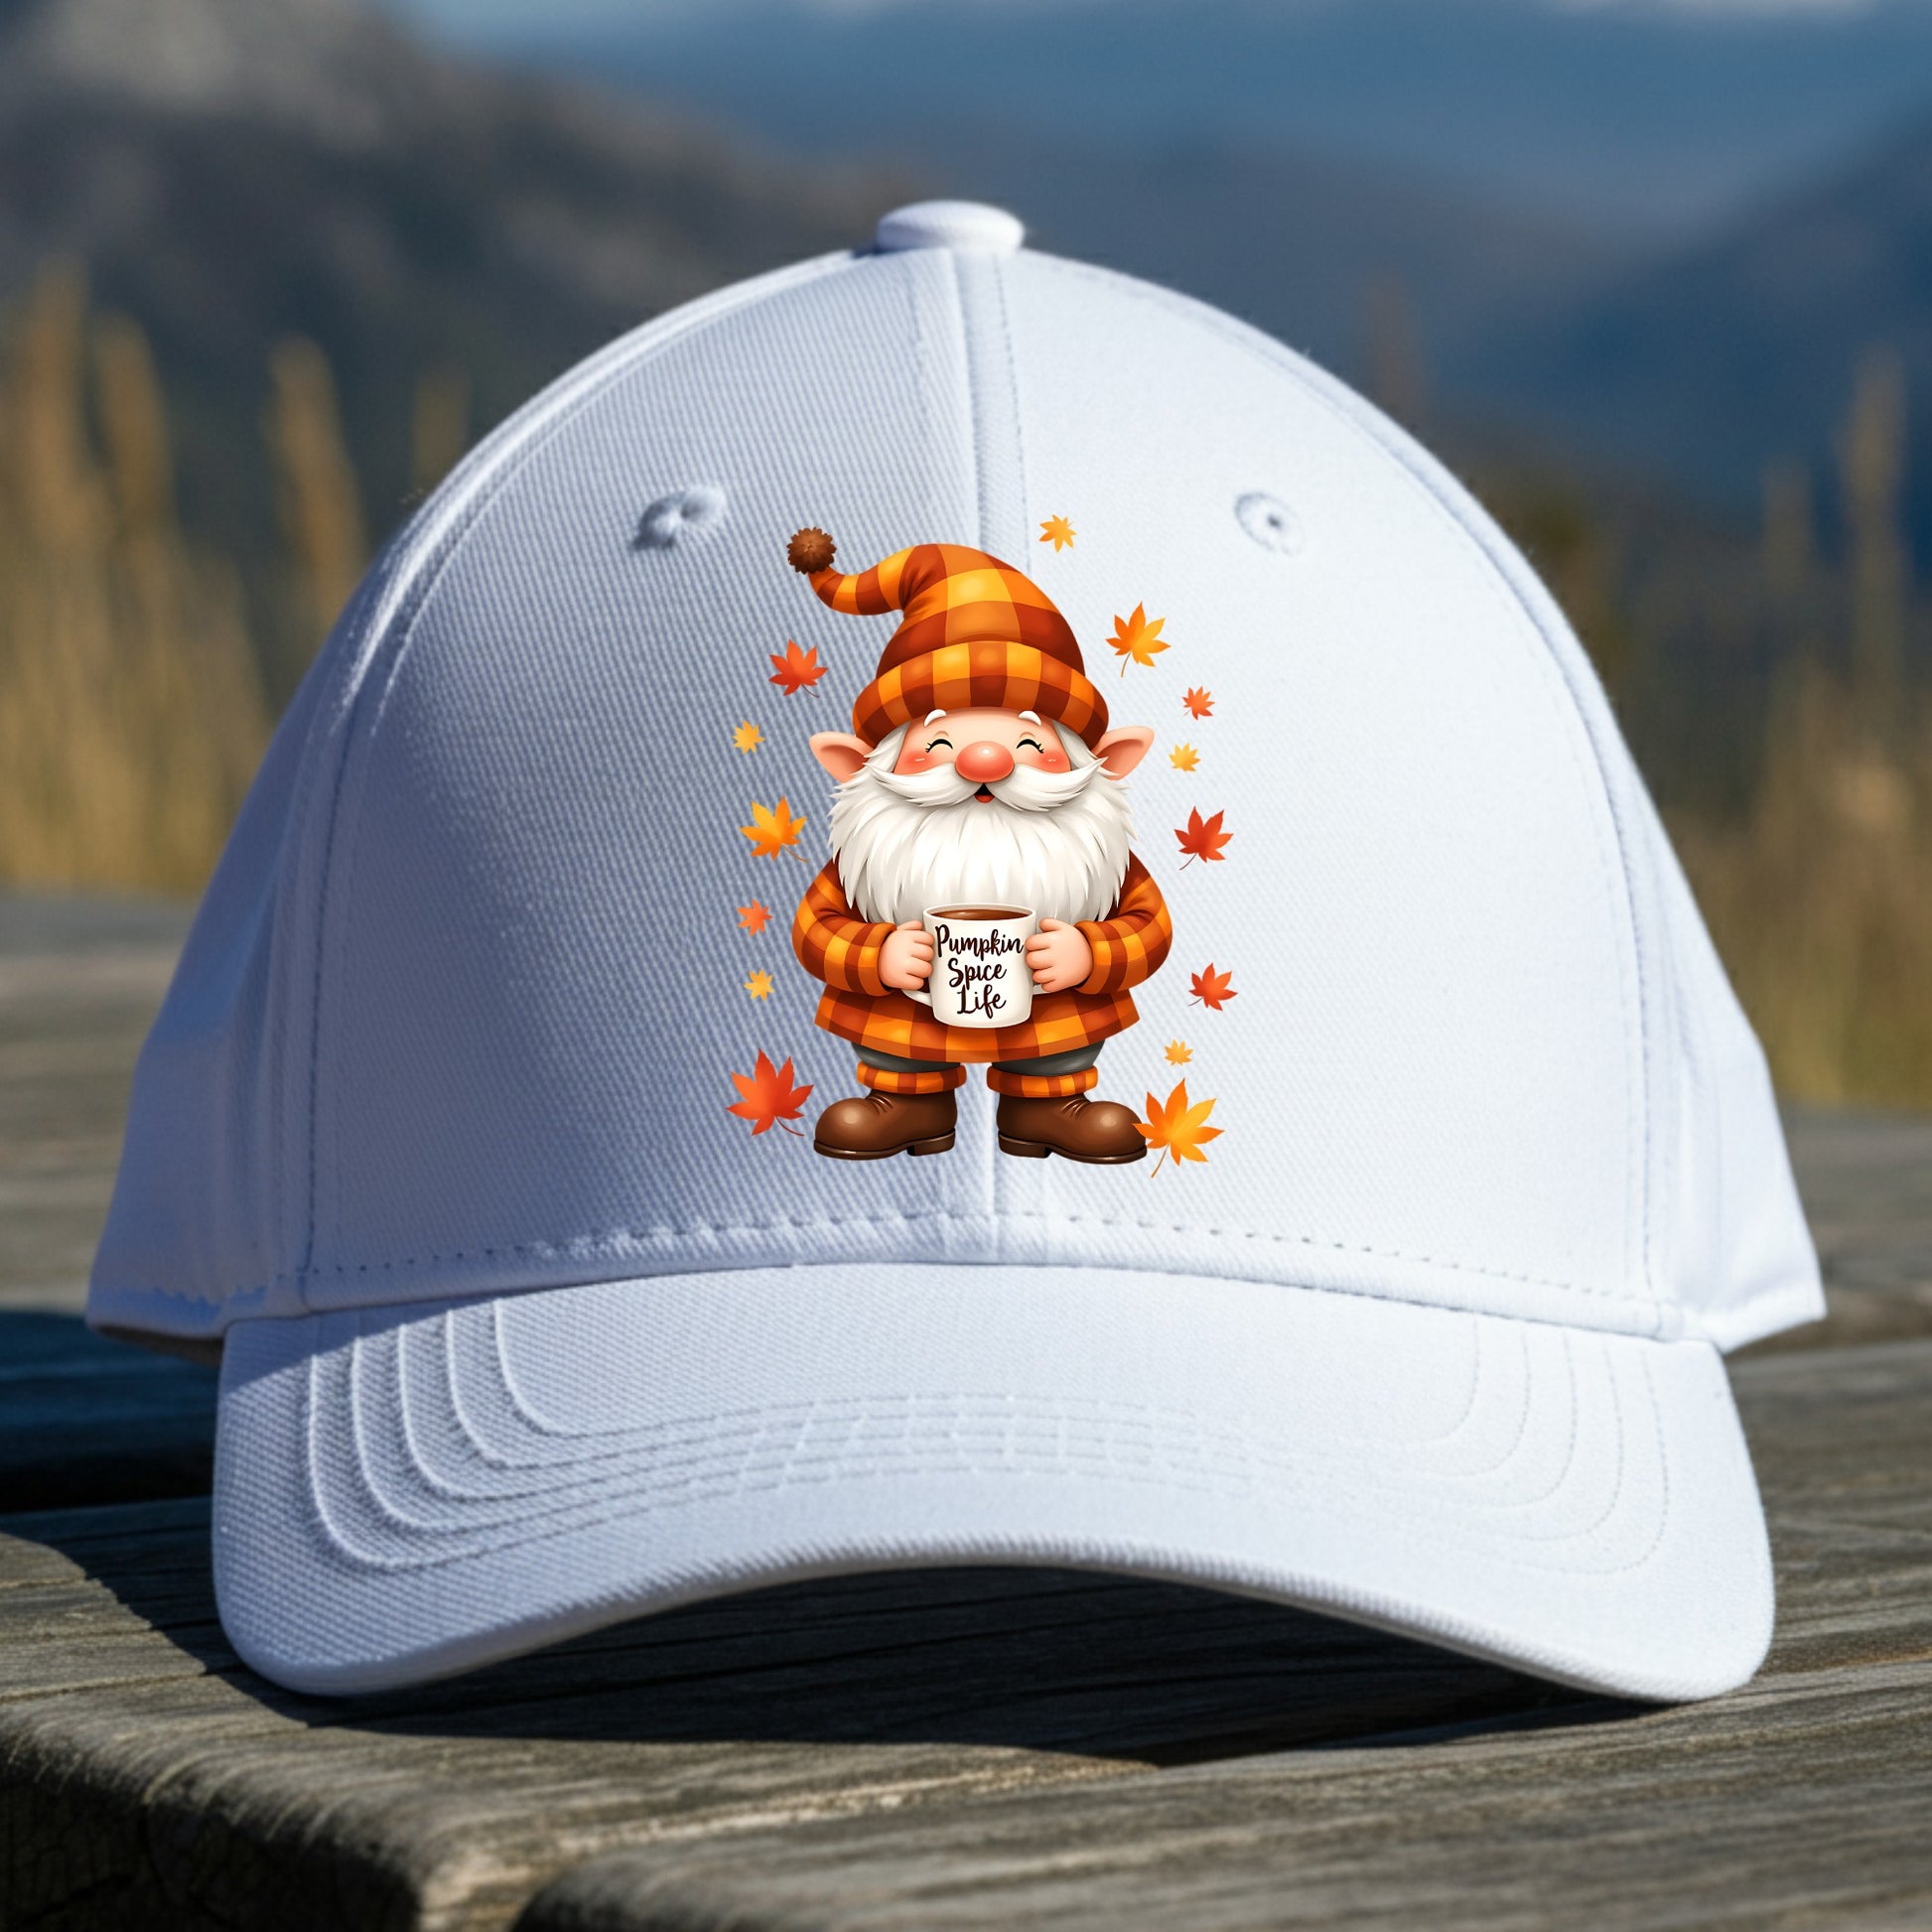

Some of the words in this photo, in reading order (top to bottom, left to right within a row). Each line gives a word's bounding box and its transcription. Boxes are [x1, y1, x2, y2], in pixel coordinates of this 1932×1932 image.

[934, 923, 1025, 962] Pumpkin
[947, 957, 1007, 990] Spice
[956, 984, 1007, 1019] Life
